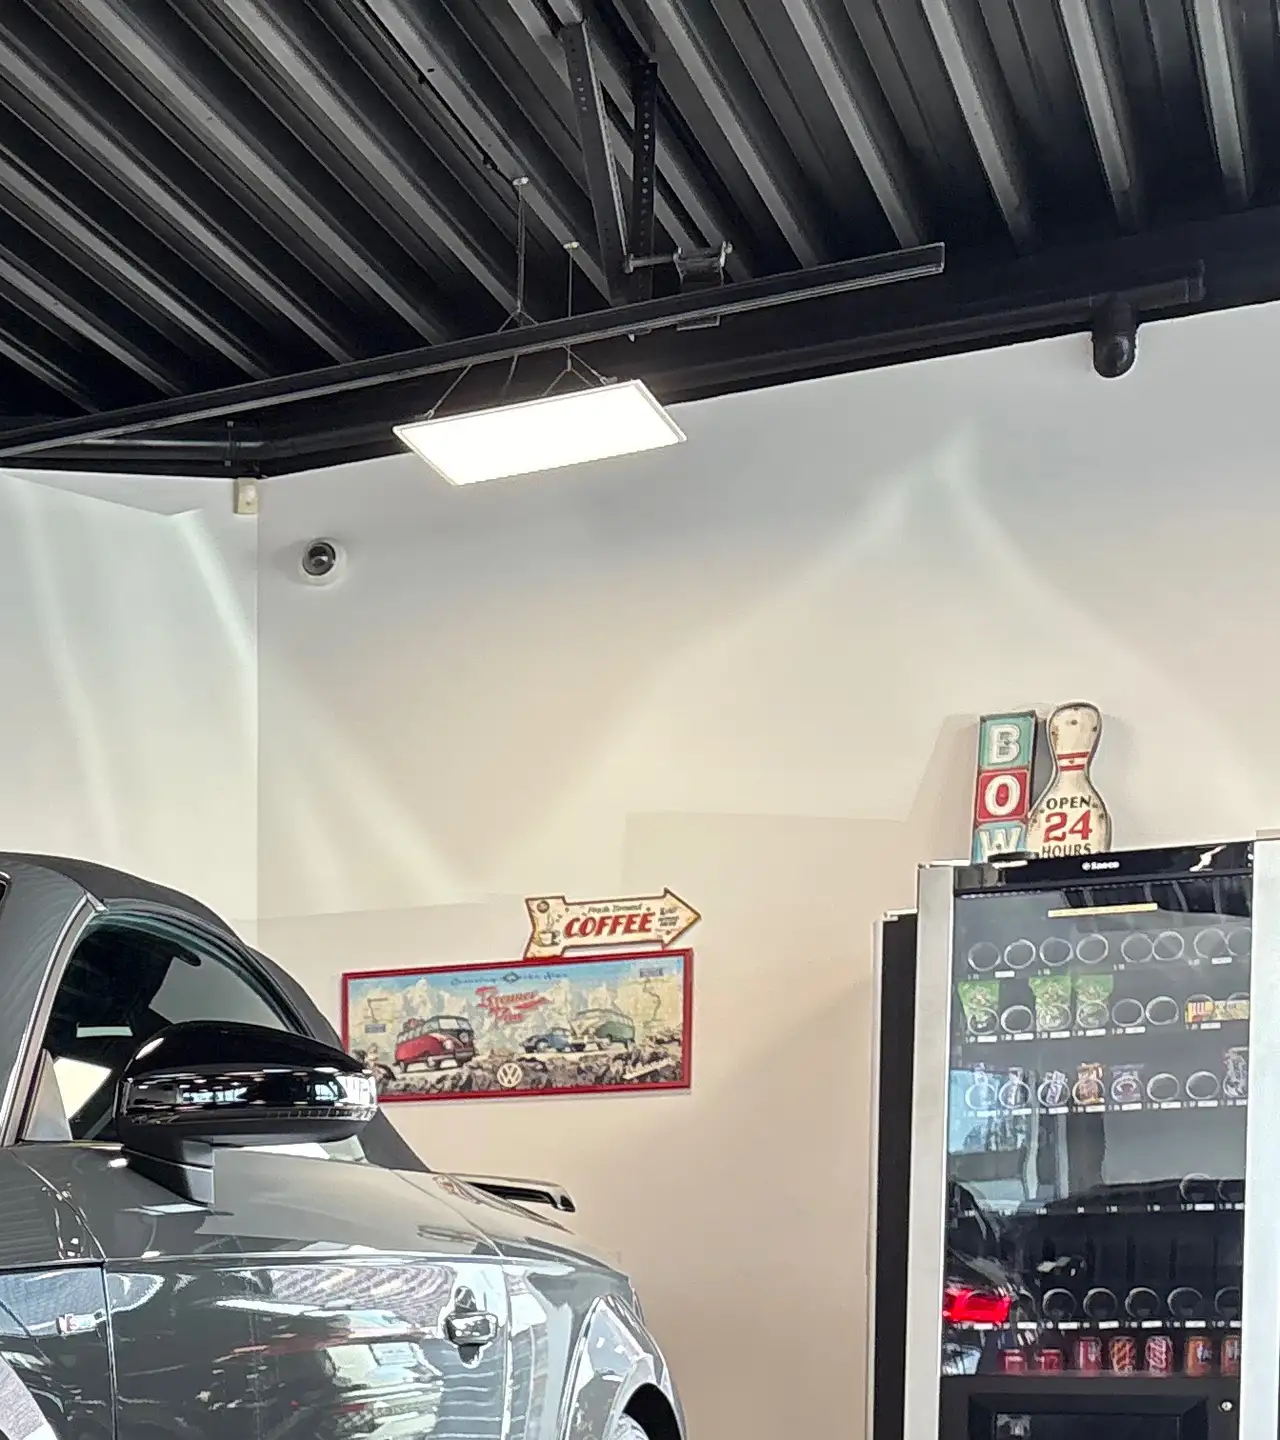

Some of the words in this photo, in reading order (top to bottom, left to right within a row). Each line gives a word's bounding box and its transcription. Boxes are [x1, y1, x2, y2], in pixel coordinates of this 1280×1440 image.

[1046, 796, 1090, 810] OPEN
[1043, 811, 1093, 843] 24
[1042, 843, 1092, 858] HOURS
[564, 911, 656, 939] COFFEE
